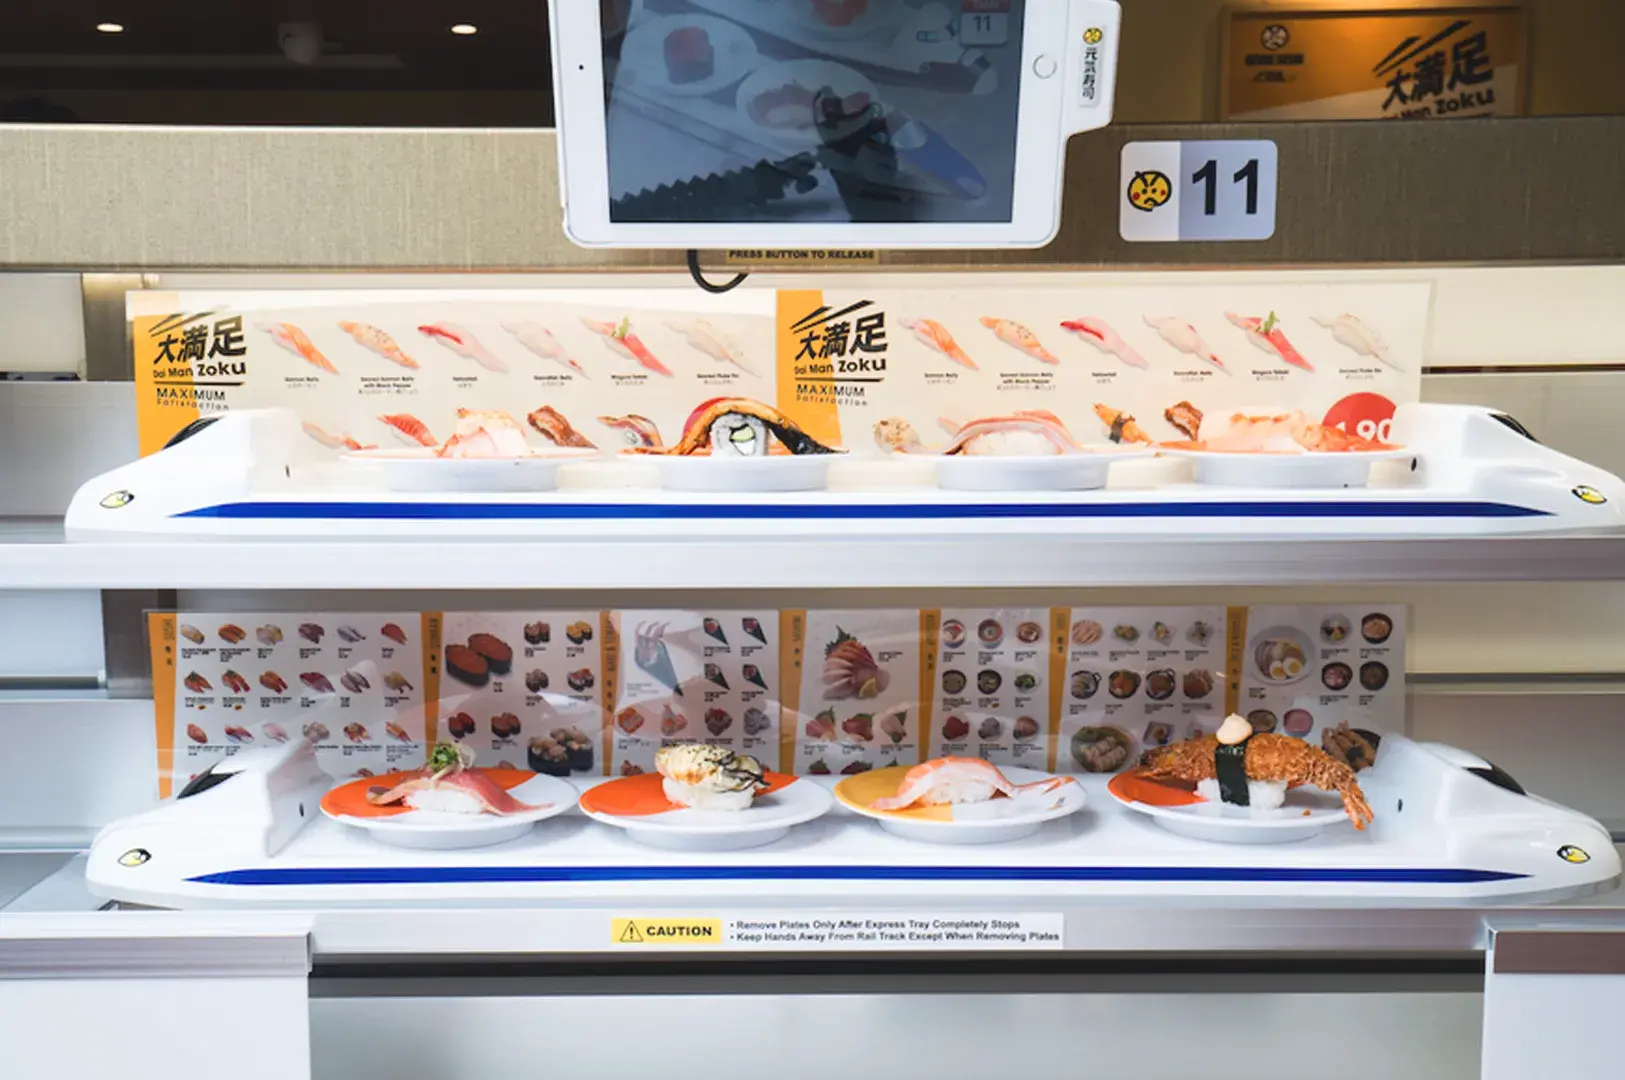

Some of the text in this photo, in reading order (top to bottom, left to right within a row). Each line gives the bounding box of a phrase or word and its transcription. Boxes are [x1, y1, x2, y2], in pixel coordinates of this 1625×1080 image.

[974, 15, 991, 32] 11
[1382, 31, 1494, 111] 大満足
[1192, 159, 1258, 215] 11
[729, 250, 875, 259] PRESS BUTTON TO RELEASE
[153, 315, 247, 365] 大満足
[794, 311, 888, 361] 大満足
[157, 388, 226, 400] MAXIMUM
[796, 384, 865, 397] MAXIMUM
[646, 926, 712, 937] CAUTION
[736, 920, 1020, 930] Remove Plates Only After Express Tray Completely Stops
[736, 931, 1060, 942] Keep Hands Away From Rail Track Except When Removing Plates
